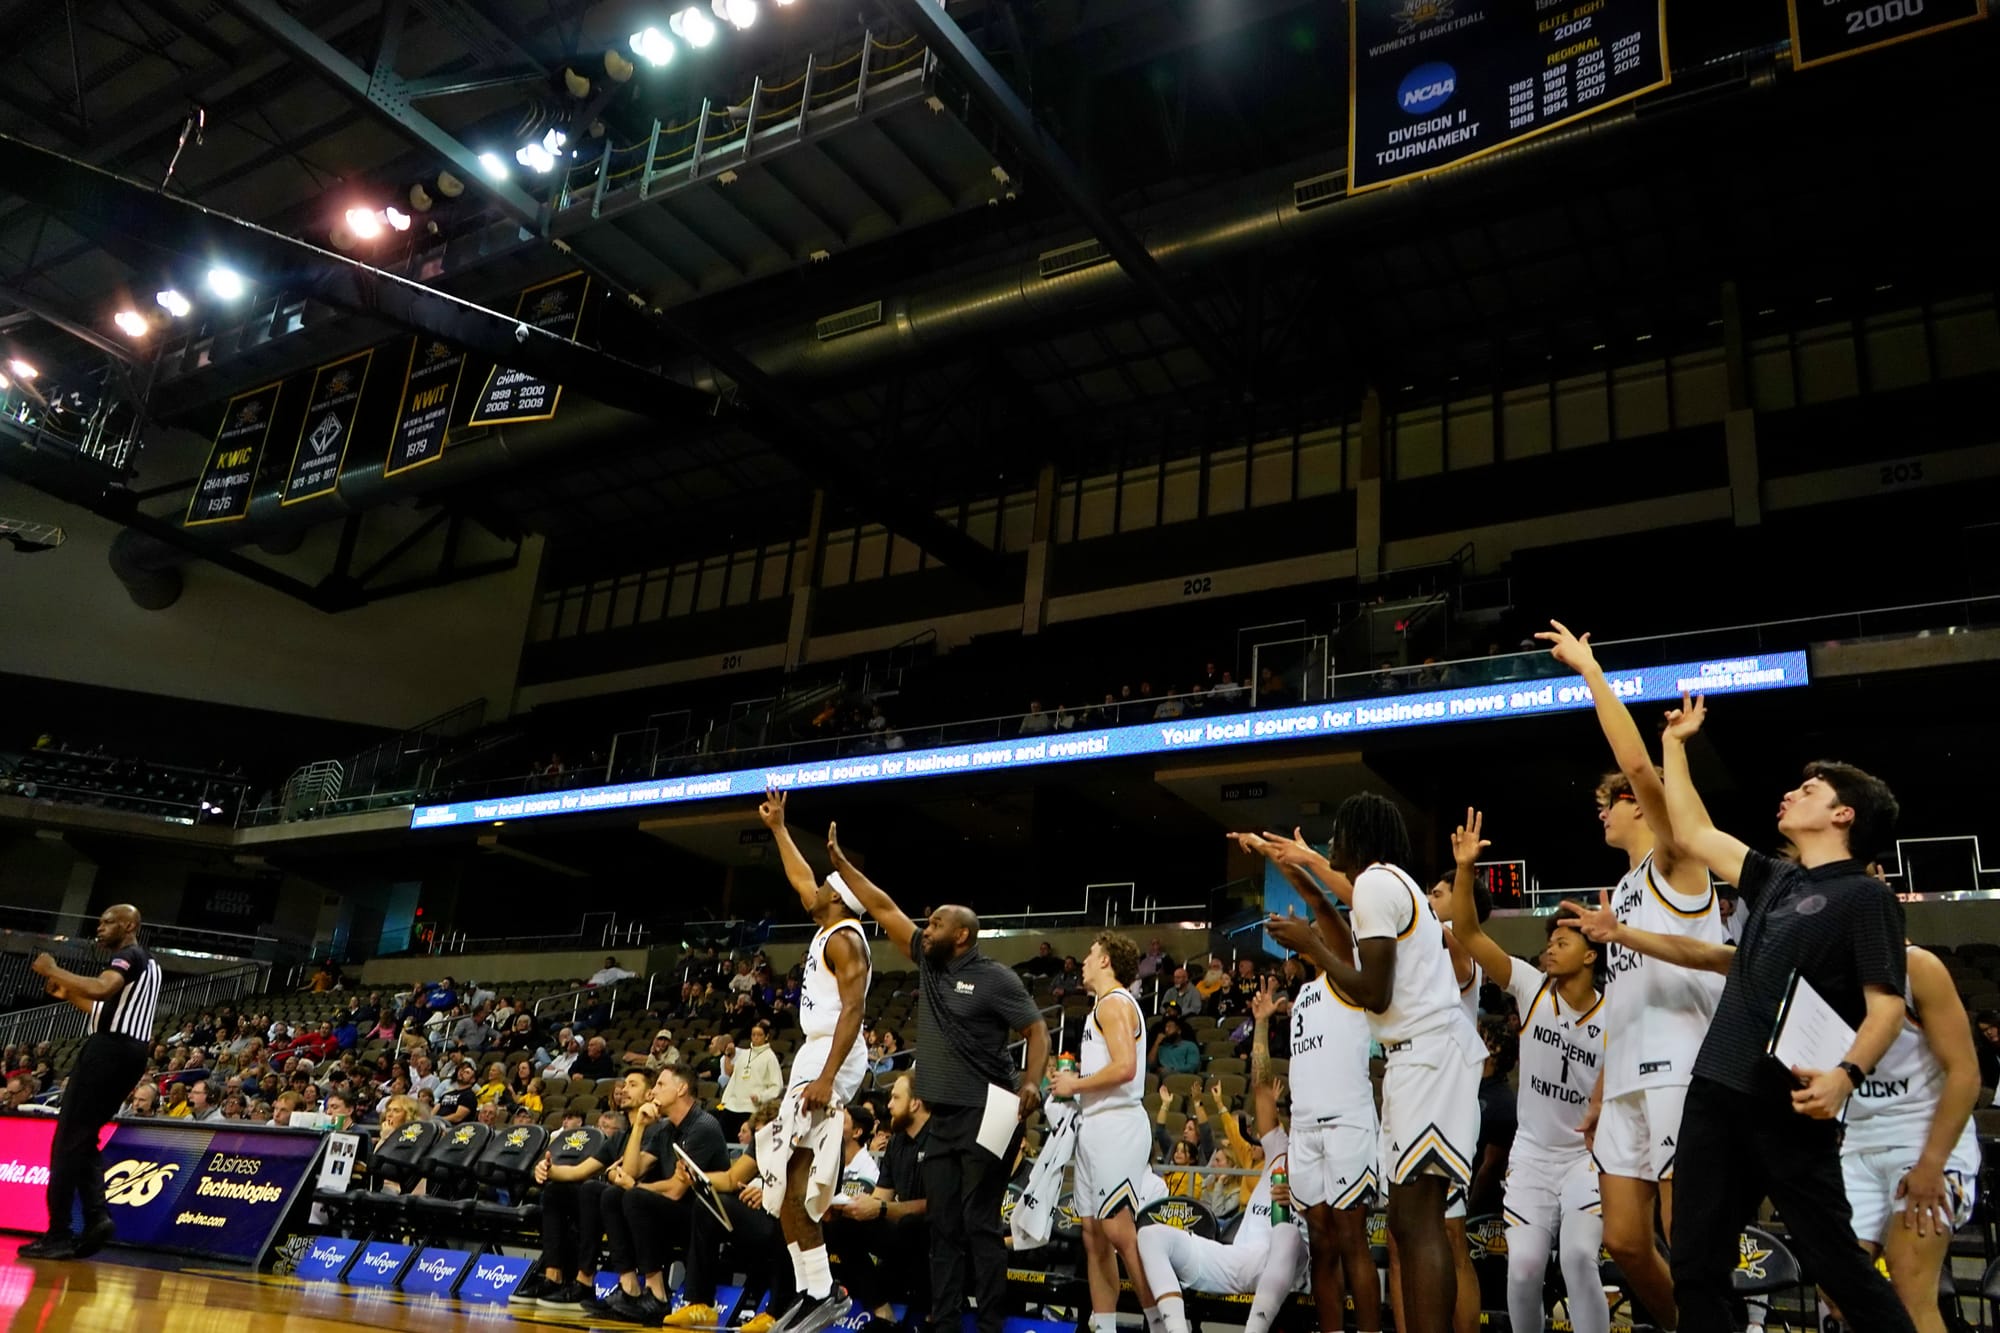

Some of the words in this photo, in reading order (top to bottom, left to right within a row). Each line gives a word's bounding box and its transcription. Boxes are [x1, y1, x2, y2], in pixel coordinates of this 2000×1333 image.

[1538, 12, 1568, 33] ELITE
[1573, 0, 1605, 18] EIGHT
[1554, 17, 1592, 41] 2002
[1846, 0, 1924, 34] 2000
[1369, 35, 1416, 57] WOMEN'S
[1419, 11, 1485, 41] BASKETBALL
[1547, 36, 1600, 66] REGIONAL
[1577, 48, 1603, 67] 2001
[1611, 31, 1641, 52] 2009
[1543, 87, 1568, 105] 1992
[1576, 72, 1606, 92] 2006
[1614, 56, 1640, 76] 2012
[1544, 76, 1566, 93] 1991
[1576, 60, 1605, 80] 2004
[1614, 44, 1640, 63] 2010
[1404, 79, 1454, 106] NCAA
[1543, 99, 1568, 117] 1994
[1577, 83, 1606, 103] 2007
[1388, 113, 1452, 145] DIVISION
[1458, 108, 1467, 123] II
[1375, 122, 1480, 166] TOURNAMENT
[411, 383, 449, 413] NWIT
[519, 385, 546, 397] 2000
[484, 400, 510, 413] 2006
[517, 398, 544, 410] 2009
[216, 446, 253, 471] KWIC
[406, 438, 428, 458] 1979
[203, 472, 250, 491] CHAMPIONS
[1880, 463, 1922, 484] 203
[208, 496, 232, 512] 1976
[1184, 577, 1211, 595] 202
[722, 655, 741, 670] 201
[1161, 728, 1202, 745] Your
[1206, 719, 1250, 741] local
[1255, 718, 1317, 736] source
[1323, 710, 1352, 729] for
[1356, 700, 1445, 726] business
[1450, 691, 1505, 715] news
[1511, 686, 1553, 709] and
[766, 771, 795, 787] Your
[798, 764, 830, 784] local
[832, 764, 878, 780] source
[882, 757, 904, 777] for
[906, 752, 969, 773] business
[973, 750, 1012, 766] news
[1016, 743, 1045, 760] and
[1049, 736, 1108, 758] events!
[474, 804, 497, 818] Your
[498, 800, 523, 817] local
[525, 798, 560, 813] source
[562, 795, 579, 811] for
[580, 790, 627, 808] business
[629, 787, 660, 801] news
[662, 781, 684, 798] and
[686, 778, 731, 797] events!
[1295, 1013, 1304, 1038] 3
[1292, 1034, 1323, 1056] TUCKY
[1561, 1055, 1569, 1084] 1
[1531, 1074, 1591, 1106] KENTUCK
[1858, 1077, 1909, 1098] UCKY
[208, 1153, 261, 1175] Business
[196, 1176, 282, 1204] Technologies
[176, 1210, 227, 1228] gbs-inc.com
[287, 1236, 314, 1250] NORS
[318, 1245, 346, 1269] Kroger
[371, 1251, 399, 1275] Kroger
[426, 1258, 456, 1282] Kroger
[485, 1264, 517, 1290] Kroger
